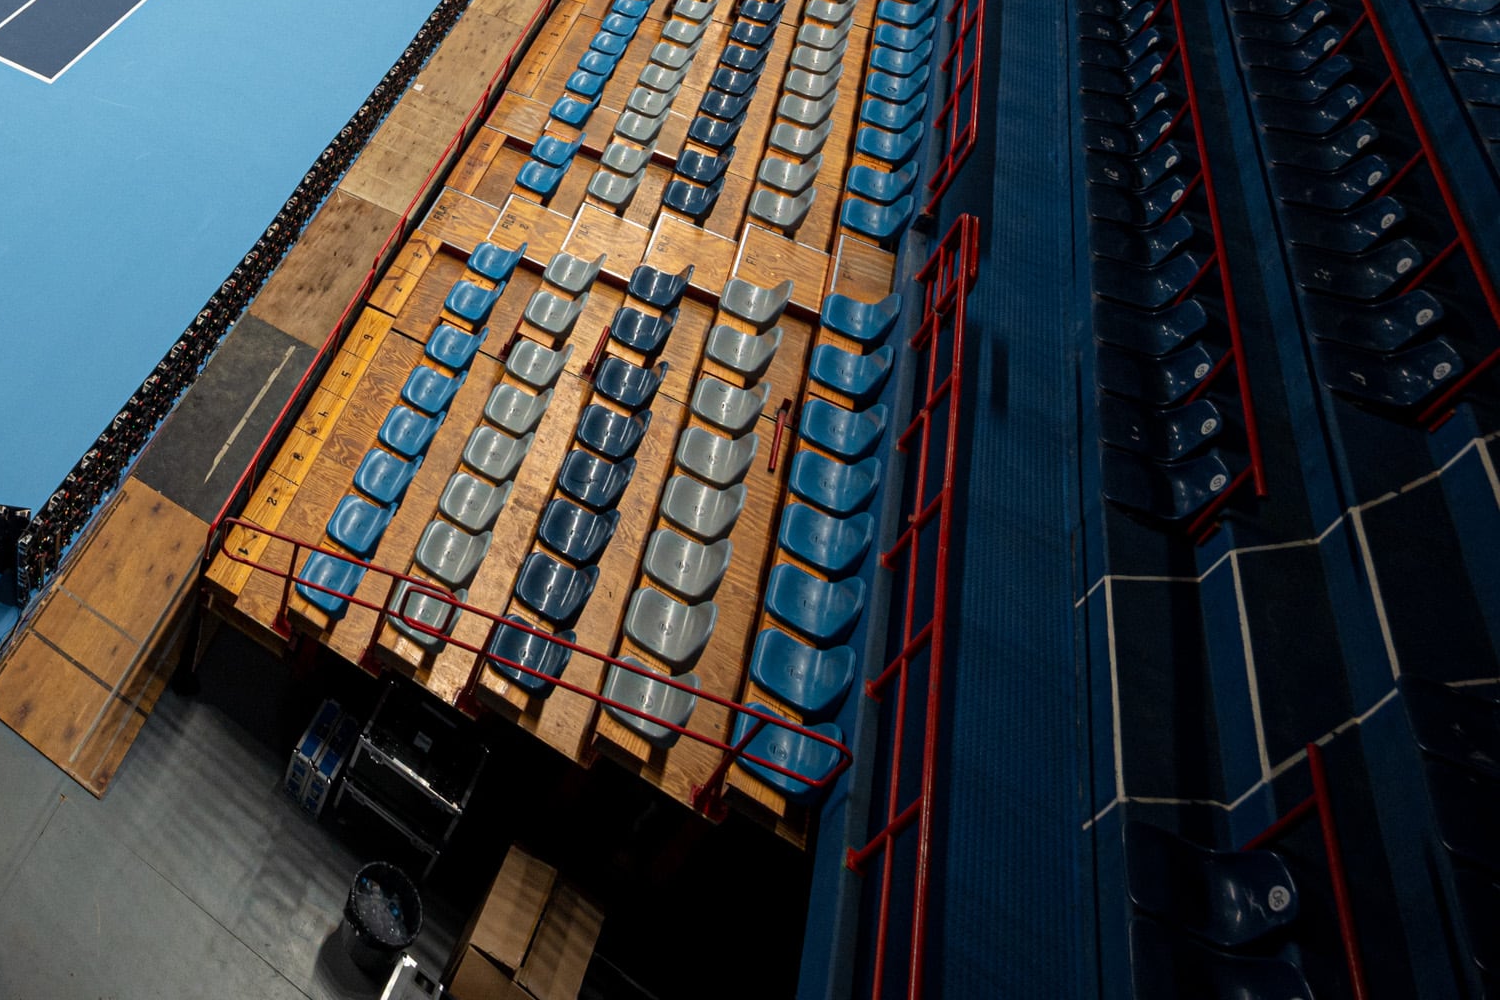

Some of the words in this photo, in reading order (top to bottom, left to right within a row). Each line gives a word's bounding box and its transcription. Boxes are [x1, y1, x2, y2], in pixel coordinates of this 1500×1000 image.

[519, 223, 529, 231] 2
[363, 333, 374, 342] 6
[341, 369, 351, 379] 5
[319, 410, 330, 419] 4
[267, 496, 278, 508] 2
